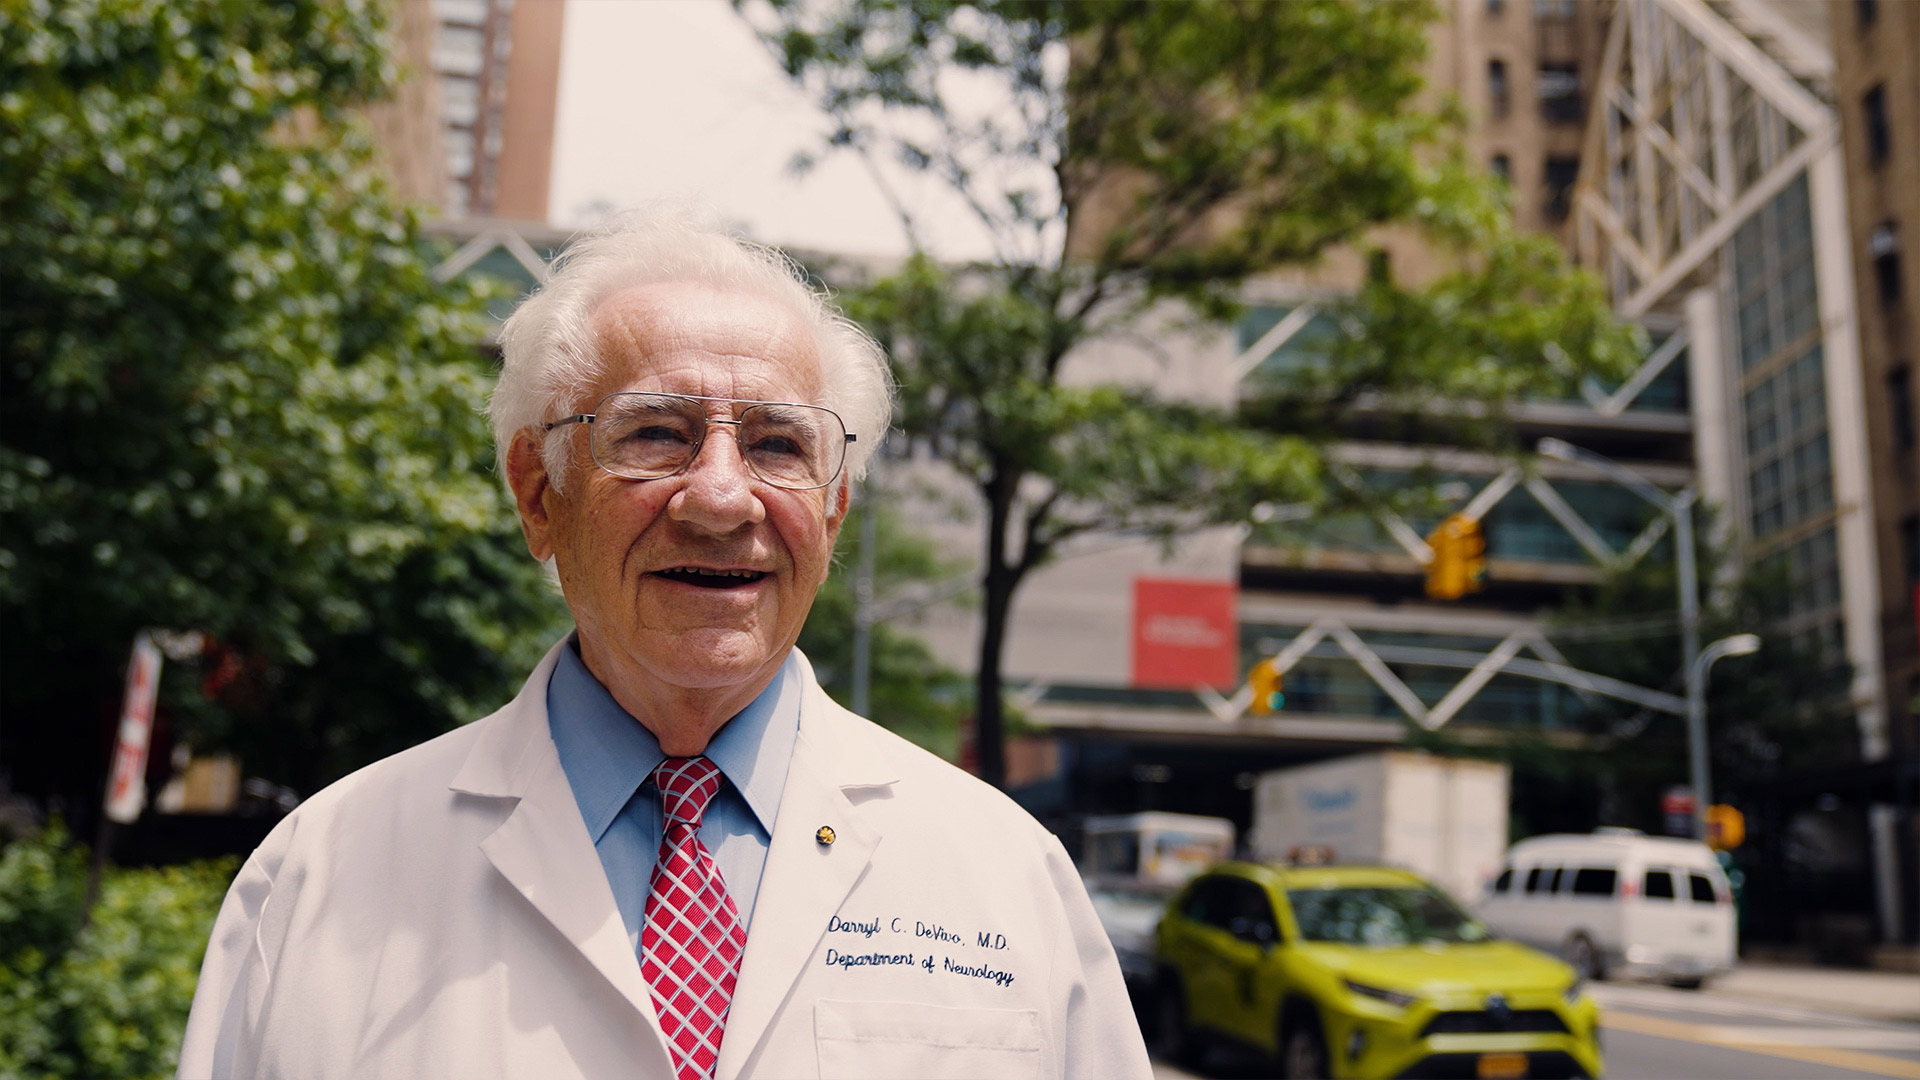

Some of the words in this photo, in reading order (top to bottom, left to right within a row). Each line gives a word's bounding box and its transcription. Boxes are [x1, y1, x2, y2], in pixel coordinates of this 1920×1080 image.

[827, 915, 881, 938] Darryl
[891, 917, 907, 933] C.
[977, 931, 1010, 951] M.D.
[825, 949, 915, 971] Department
[921, 955, 935, 973] of
[944, 957, 1015, 987] Neurology
